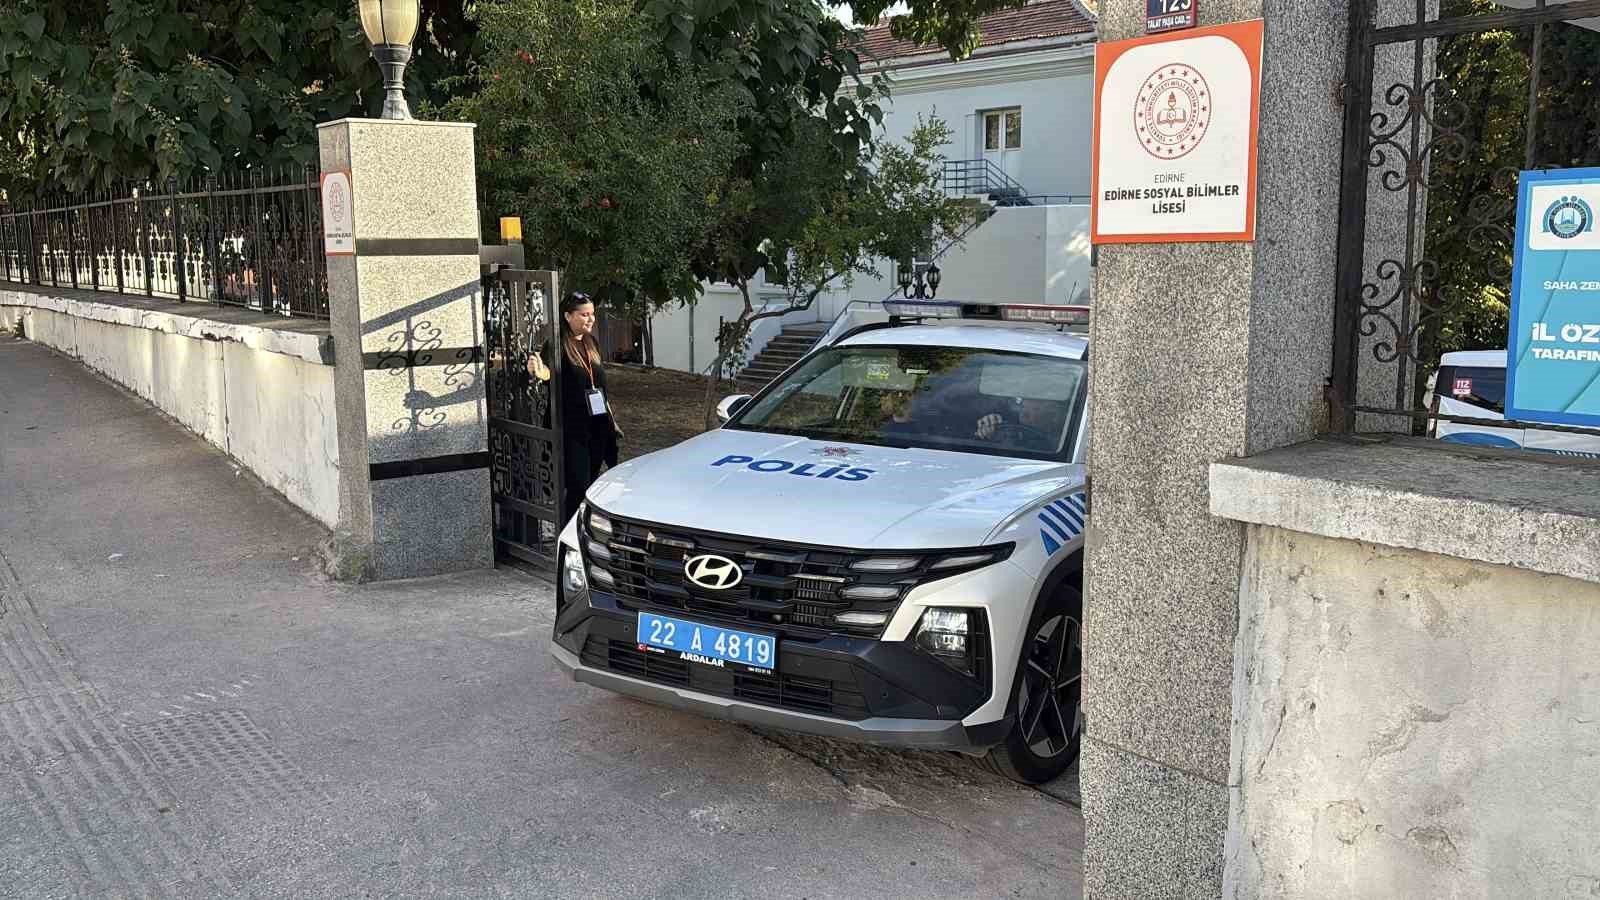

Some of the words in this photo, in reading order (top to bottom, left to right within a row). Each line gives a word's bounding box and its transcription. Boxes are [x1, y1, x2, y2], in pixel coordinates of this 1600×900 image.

[1147, 18, 1161, 29] TALAT
[1154, 173, 1185, 183] EDİRNE
[1104, 188, 1142, 200] EDİRNE
[1143, 187, 1184, 199] SOSYAL
[1187, 184, 1239, 198] BİLİMLER
[1152, 200, 1186, 214] LİSESİ
[1543, 281, 1578, 290] SAHA
[1456, 380, 1470, 389] 112
[711, 454, 876, 482] POLİS
[650, 619, 676, 646] 22
[691, 627, 703, 651] A
[714, 632, 770, 664] 4819
[680, 652, 724, 667] ARDALAR
